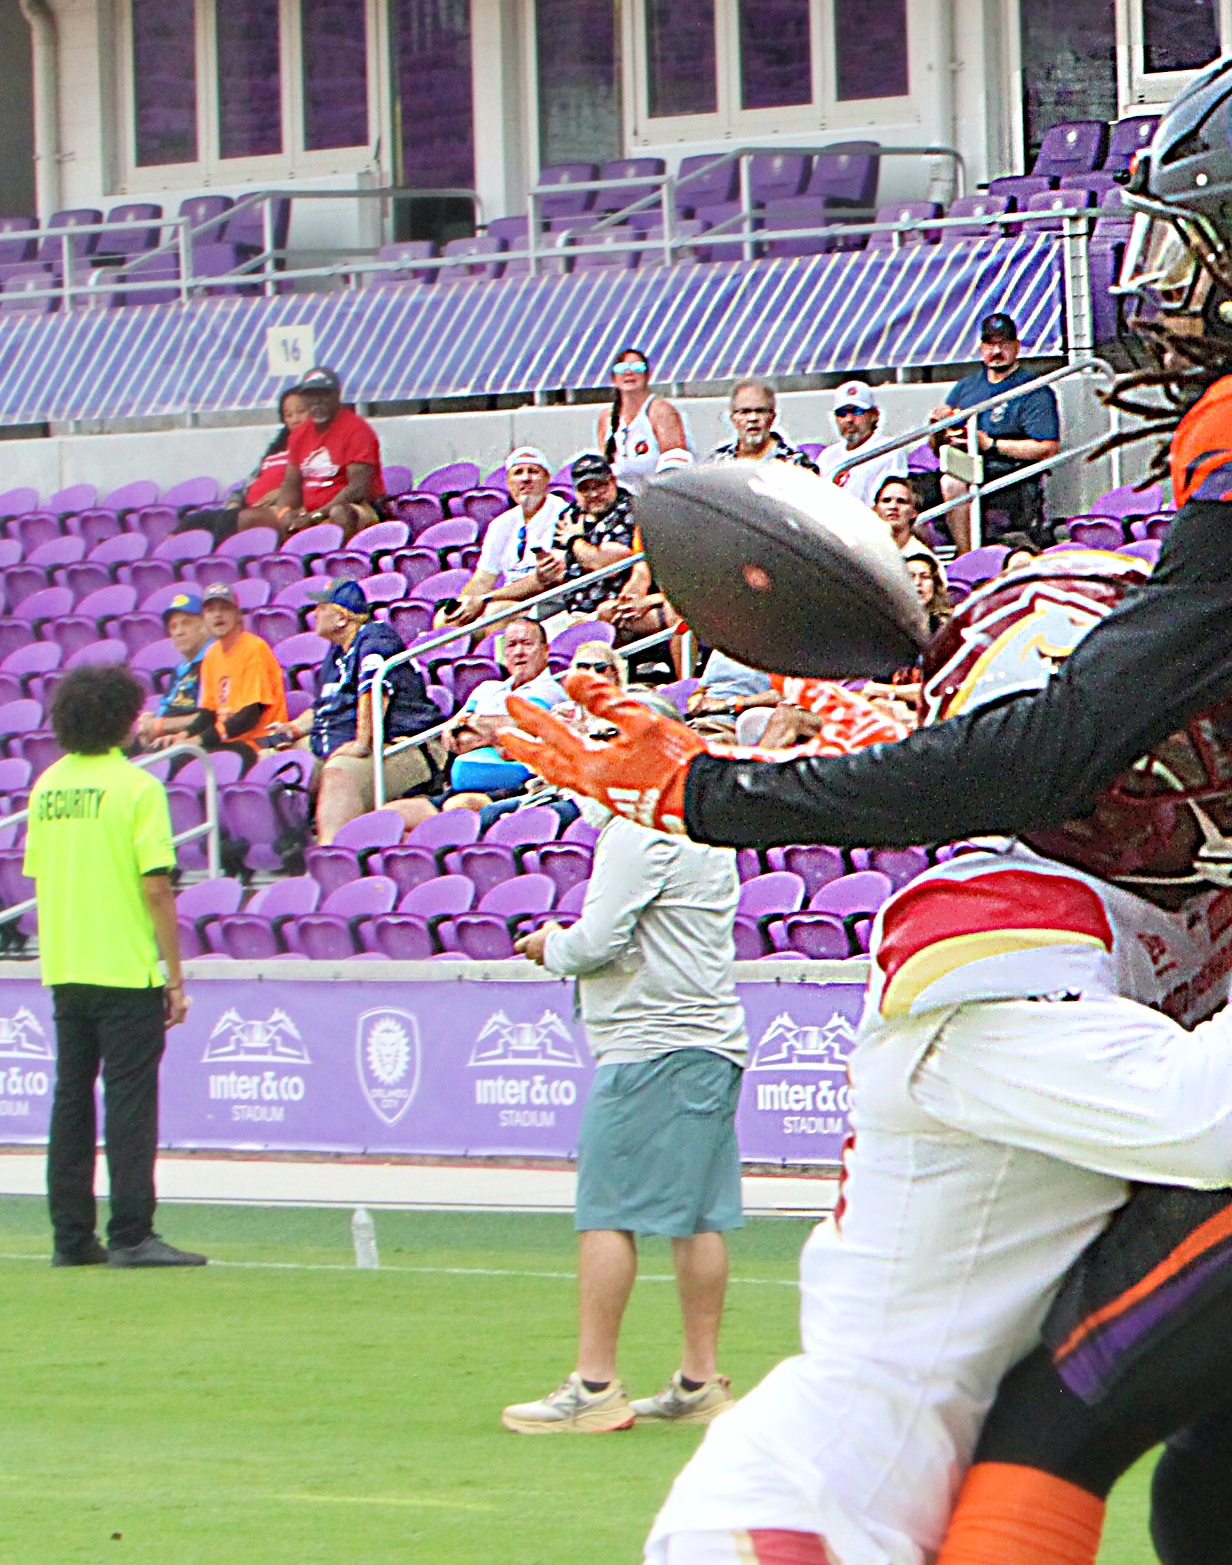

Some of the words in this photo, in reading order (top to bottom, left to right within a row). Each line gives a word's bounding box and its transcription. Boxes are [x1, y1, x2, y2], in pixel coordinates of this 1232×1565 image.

[281, 338, 302, 362] 16
[38, 788, 107, 821] SECURITY
[231, 1105, 285, 1122] STADIUM
[499, 1109, 556, 1127] STADIUM
[783, 1116, 843, 1134] STADIUM
